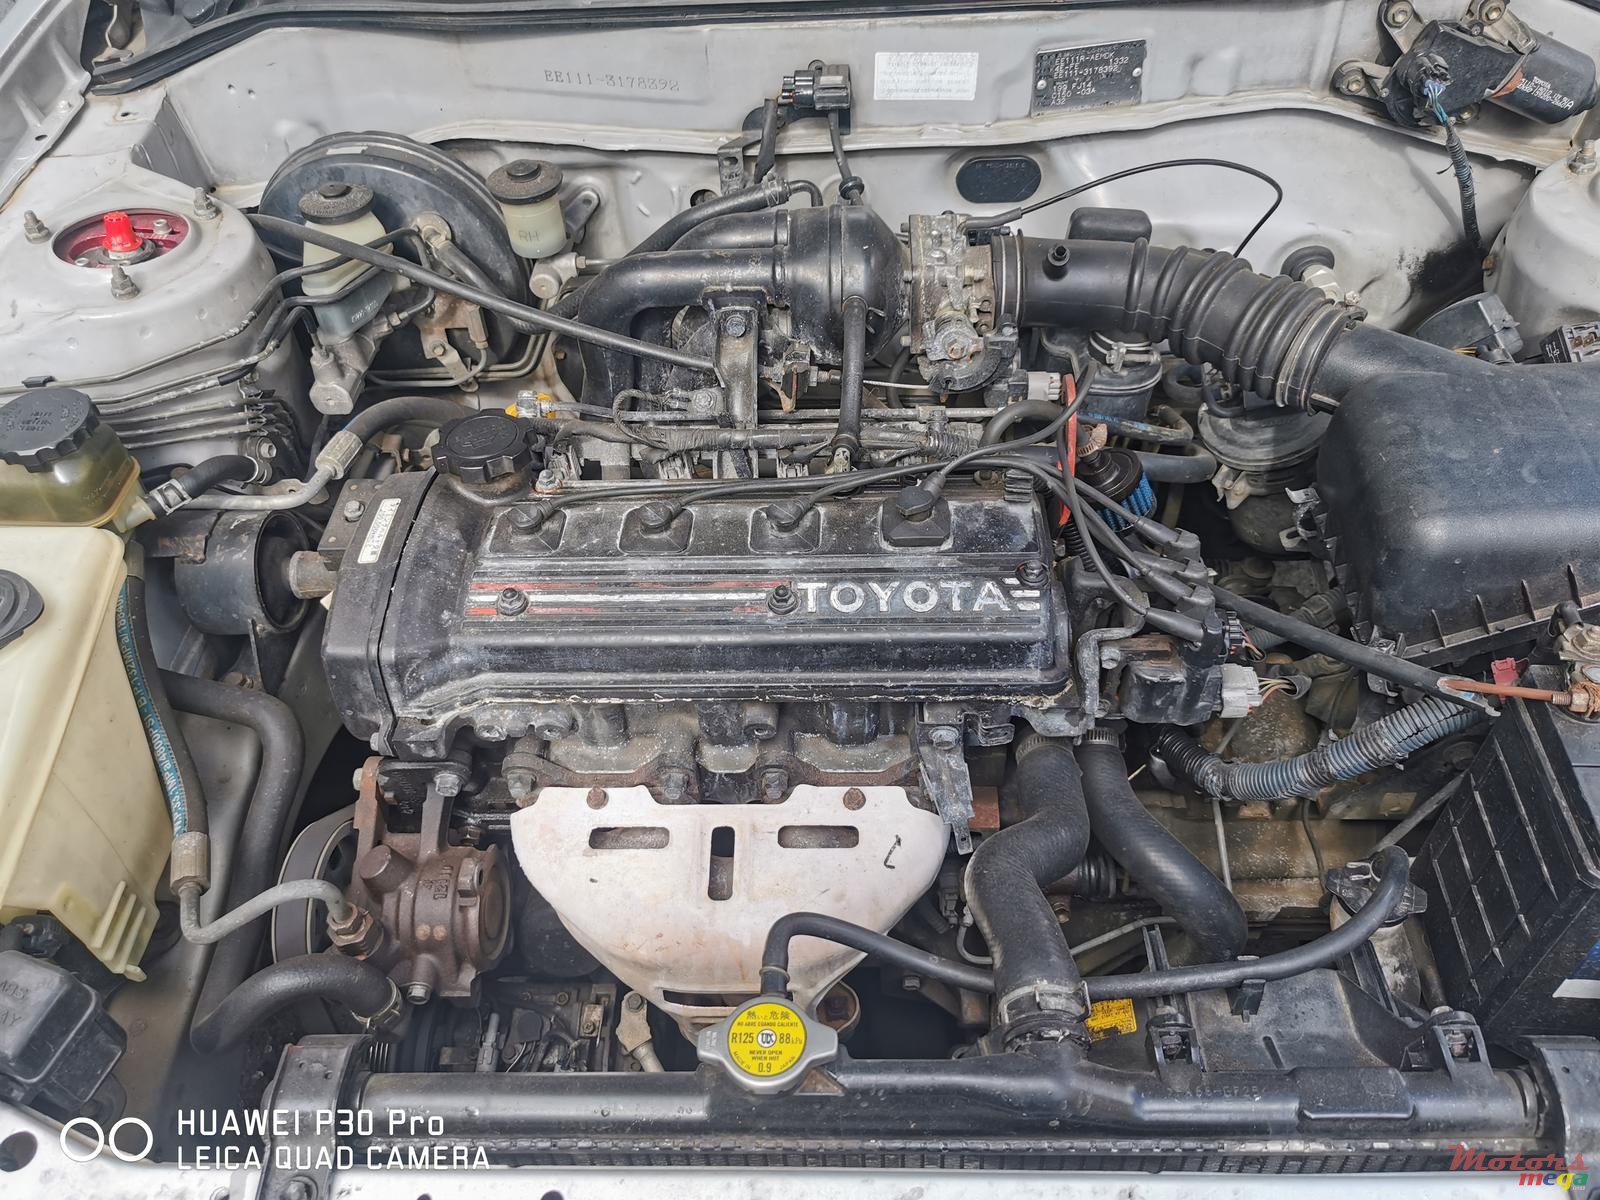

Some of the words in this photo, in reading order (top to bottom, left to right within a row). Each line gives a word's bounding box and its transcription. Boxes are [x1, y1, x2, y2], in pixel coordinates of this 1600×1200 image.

[544, 69, 680, 92] EE111-3178392
[797, 580, 1012, 613] TOYOTA
[731, 1032, 754, 1044] R125
[758, 1063, 772, 1073] 0.9
